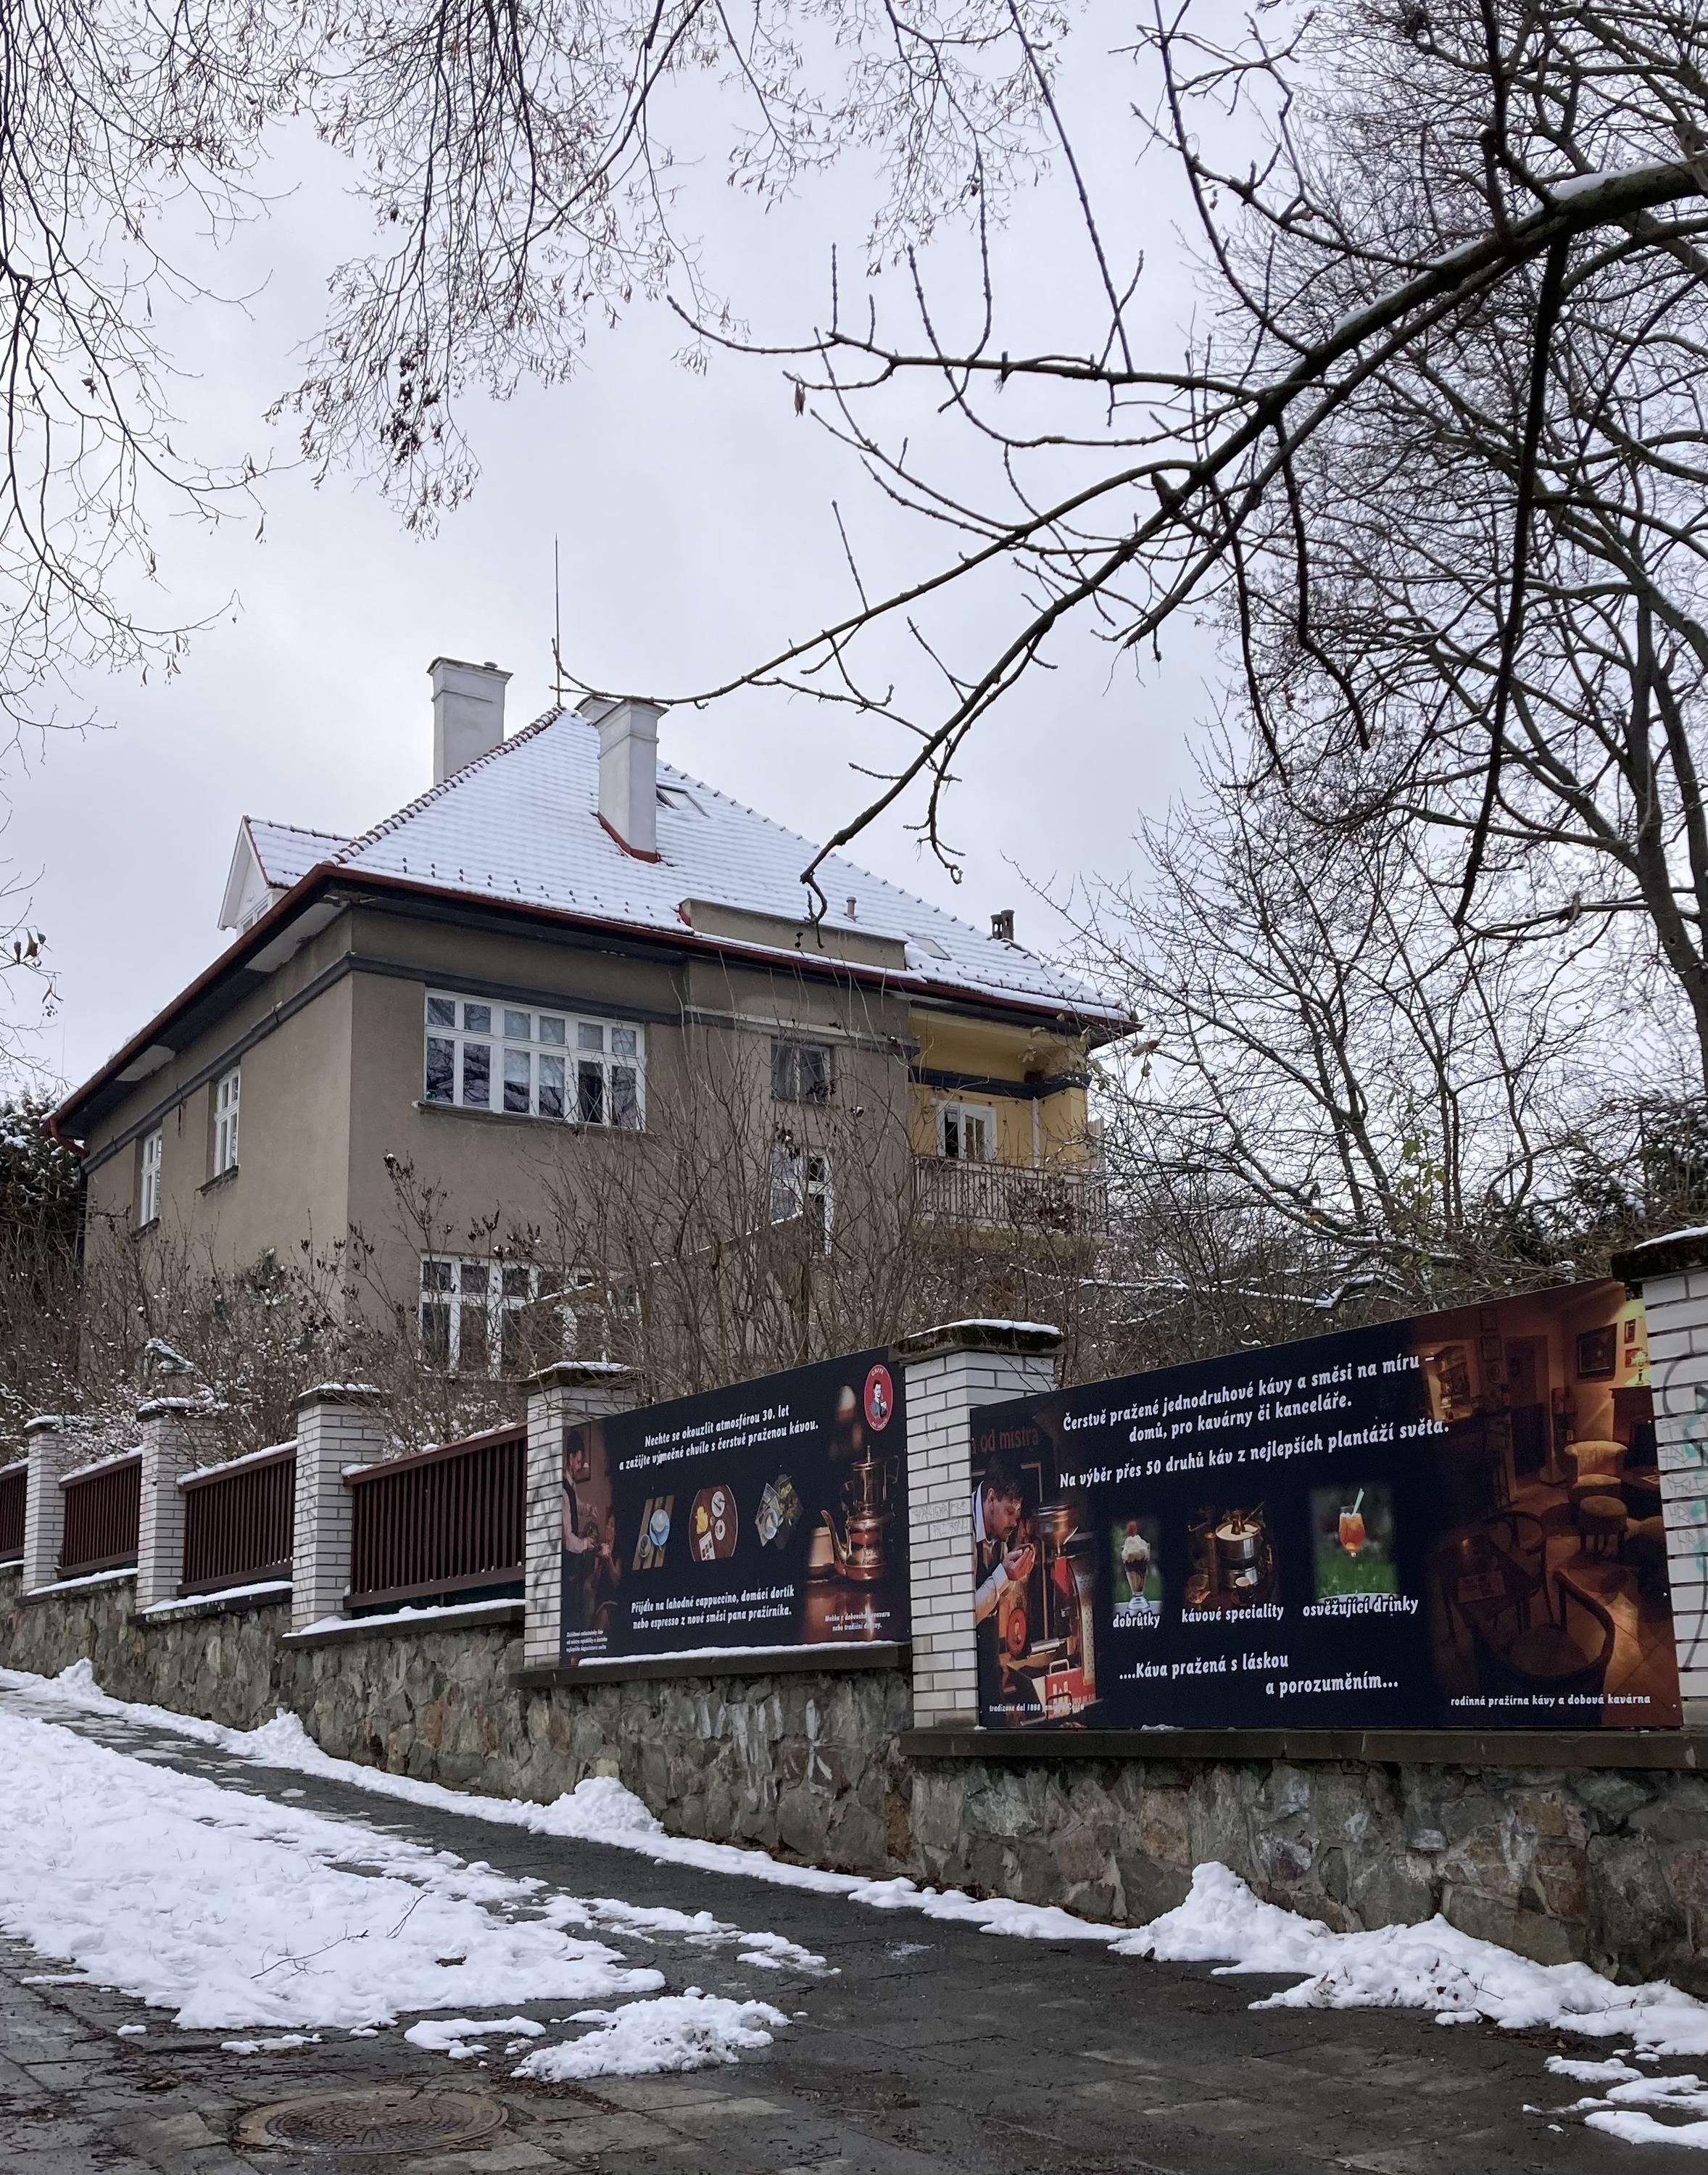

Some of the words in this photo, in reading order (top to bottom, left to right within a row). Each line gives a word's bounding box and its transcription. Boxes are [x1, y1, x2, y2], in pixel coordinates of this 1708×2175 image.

[1063, 1409, 1106, 1432] Čerstvě
[1110, 1399, 1159, 1426] pražené
[1162, 1381, 1253, 1417] jednodruhové
[1259, 1378, 1292, 1396] kávy
[1297, 1376, 1306, 1390] a
[1311, 1364, 1352, 1387] směsi
[1358, 1363, 1377, 1379] na
[1382, 1354, 1420, 1374] míru
[644, 1433, 670, 1447] Nechte
[672, 1432, 680, 1442] se
[682, 1422, 714, 1439] okouzlit
[716, 1412, 760, 1432] atmosférou
[763, 1409, 776, 1421] 30.
[778, 1404, 789, 1418] let
[1129, 1422, 1167, 1443] domů,
[1172, 1421, 1193, 1439] pro
[1198, 1409, 1253, 1432] kavárny
[1257, 1403, 1270, 1422] či
[1275, 1391, 1352, 1419] kanceláře.
[618, 1461, 624, 1470] a
[626, 1452, 651, 1469] zažijte
[686, 1440, 709, 1457] chvíle
[711, 1442, 716, 1451] s
[718, 1433, 746, 1450] čerstvě
[748, 1428, 787, 1446] praženou
[789, 1420, 819, 1436] kávou.
[980, 1428, 995, 1452] od
[999, 1425, 1038, 1449] mistra
[1059, 1472, 1076, 1488] Na
[1079, 1467, 1113, 1488] výběr
[1116, 1463, 1141, 1483] přes
[1145, 1459, 1161, 1475] 50
[1165, 1451, 1204, 1472] druhů
[1209, 1448, 1233, 1467] káv
[1238, 1449, 1245, 1462] z
[1251, 1433, 1323, 1462] nejlepších
[1327, 1422, 1394, 1453] plantáží
[1399, 1417, 1449, 1439] světa.
[655, 1601, 664, 1611] na
[666, 1595, 694, 1610] lahodné
[695, 1591, 739, 1609] cappuccino,
[741, 1586, 768, 1602] domácí
[770, 1584, 795, 1599] dortík
[1303, 1597, 1370, 1619] osvěžující
[1372, 1595, 1419, 1615] drinky
[633, 1617, 649, 1630] nebo
[650, 1617, 679, 1631] espresso
[681, 1615, 685, 1626] z
[687, 1612, 704, 1625] nové
[706, 1610, 726, 1623] směsi
[728, 1610, 747, 1623] pana
[748, 1604, 792, 1622] pražírníka.
[1112, 1612, 1161, 1629] dobrůtky
[1181, 1607, 1222, 1624] kávové
[1225, 1603, 1284, 1623] speciality
[1171, 1654, 1227, 1680] pražená
[1230, 1658, 1238, 1672] s
[1242, 1652, 1289, 1670] láskou
[1266, 1681, 1274, 1695] a
[1279, 1670, 1398, 1699] porozuměním...
[1016, 1703, 1026, 1712] dal
[1451, 1695, 1485, 1706] rodinná
[1488, 1694, 1529, 1707] pražírna
[1532, 1694, 1555, 1707] kávy
[1558, 1696, 1565, 1704] a
[1567, 1694, 1604, 1704] dobová
[1607, 1694, 1651, 1704] kavárna
